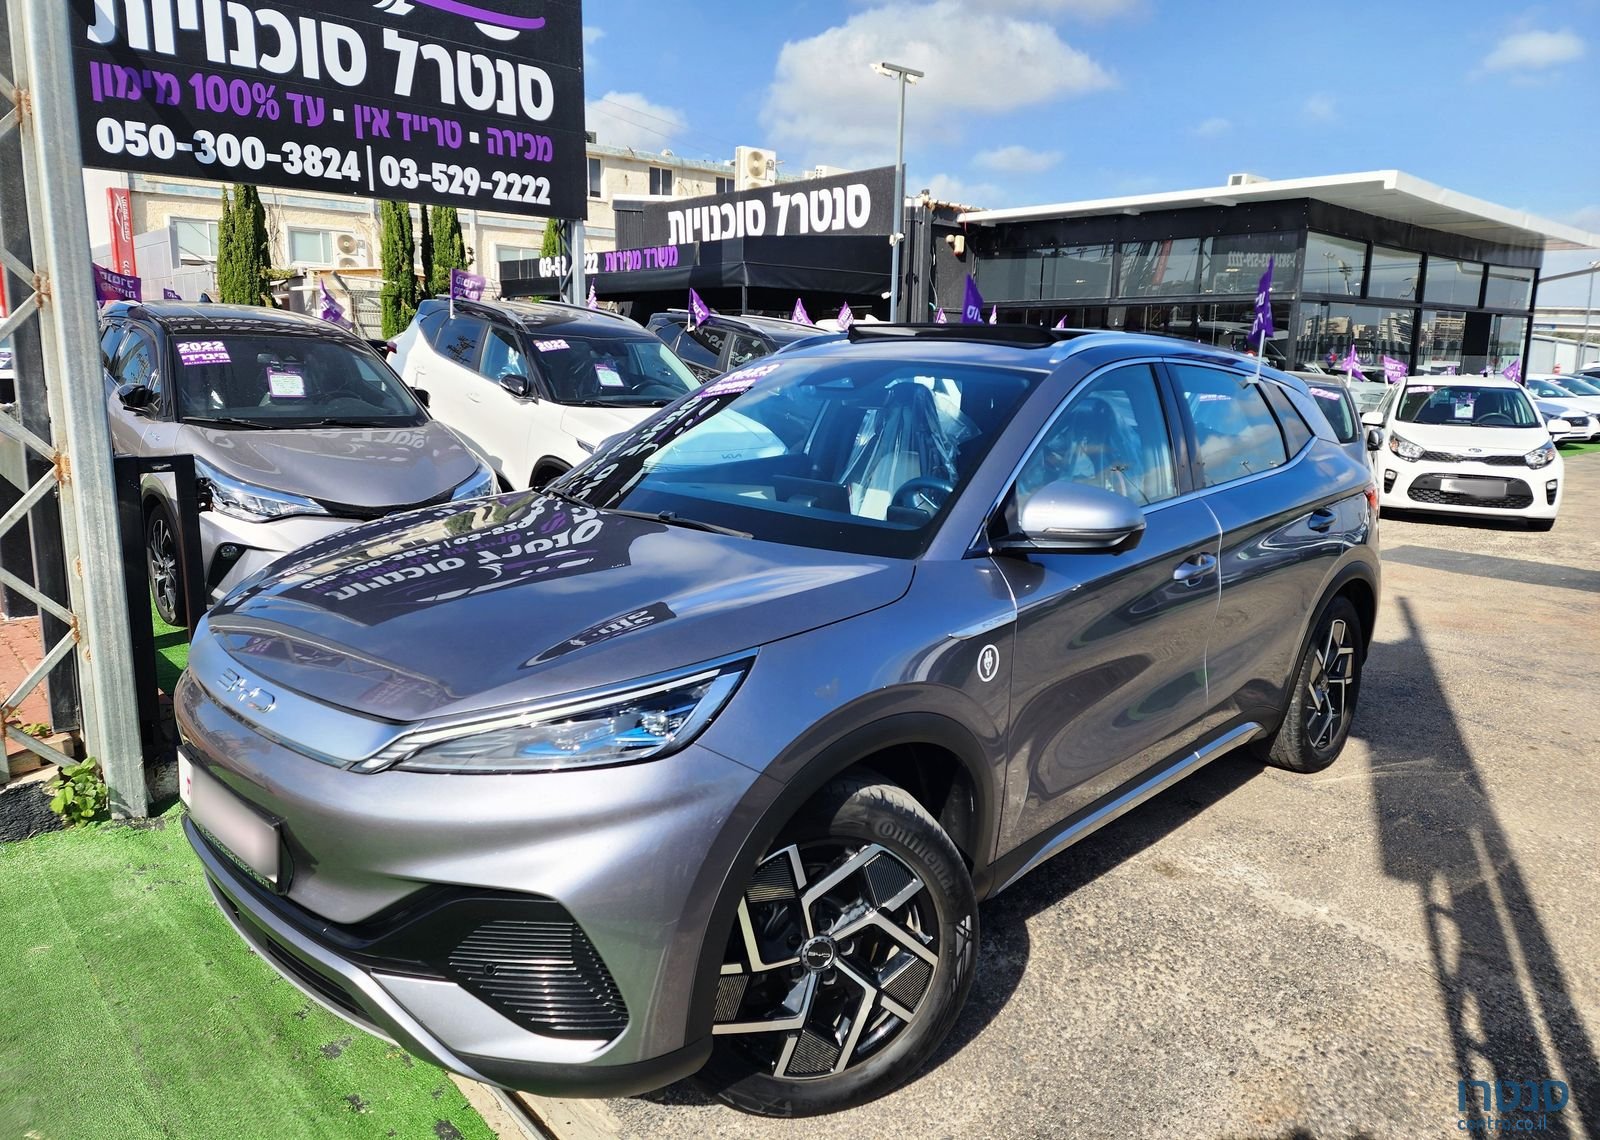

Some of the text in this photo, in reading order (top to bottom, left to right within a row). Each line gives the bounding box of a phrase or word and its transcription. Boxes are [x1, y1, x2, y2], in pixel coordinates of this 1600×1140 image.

[87, 0, 554, 120] סנטרל סוכנויות
[91, 62, 553, 162] מכירה טרייד אין עד 100% מימון
[97, 118, 551, 205] 050-300-3824 03-529-2222
[668, 184, 871, 246] סנטרל סוכנויות
[605, 249, 643, 272] מכירות
[644, 245, 679, 269] משרד
[177, 341, 225, 352] 2022
